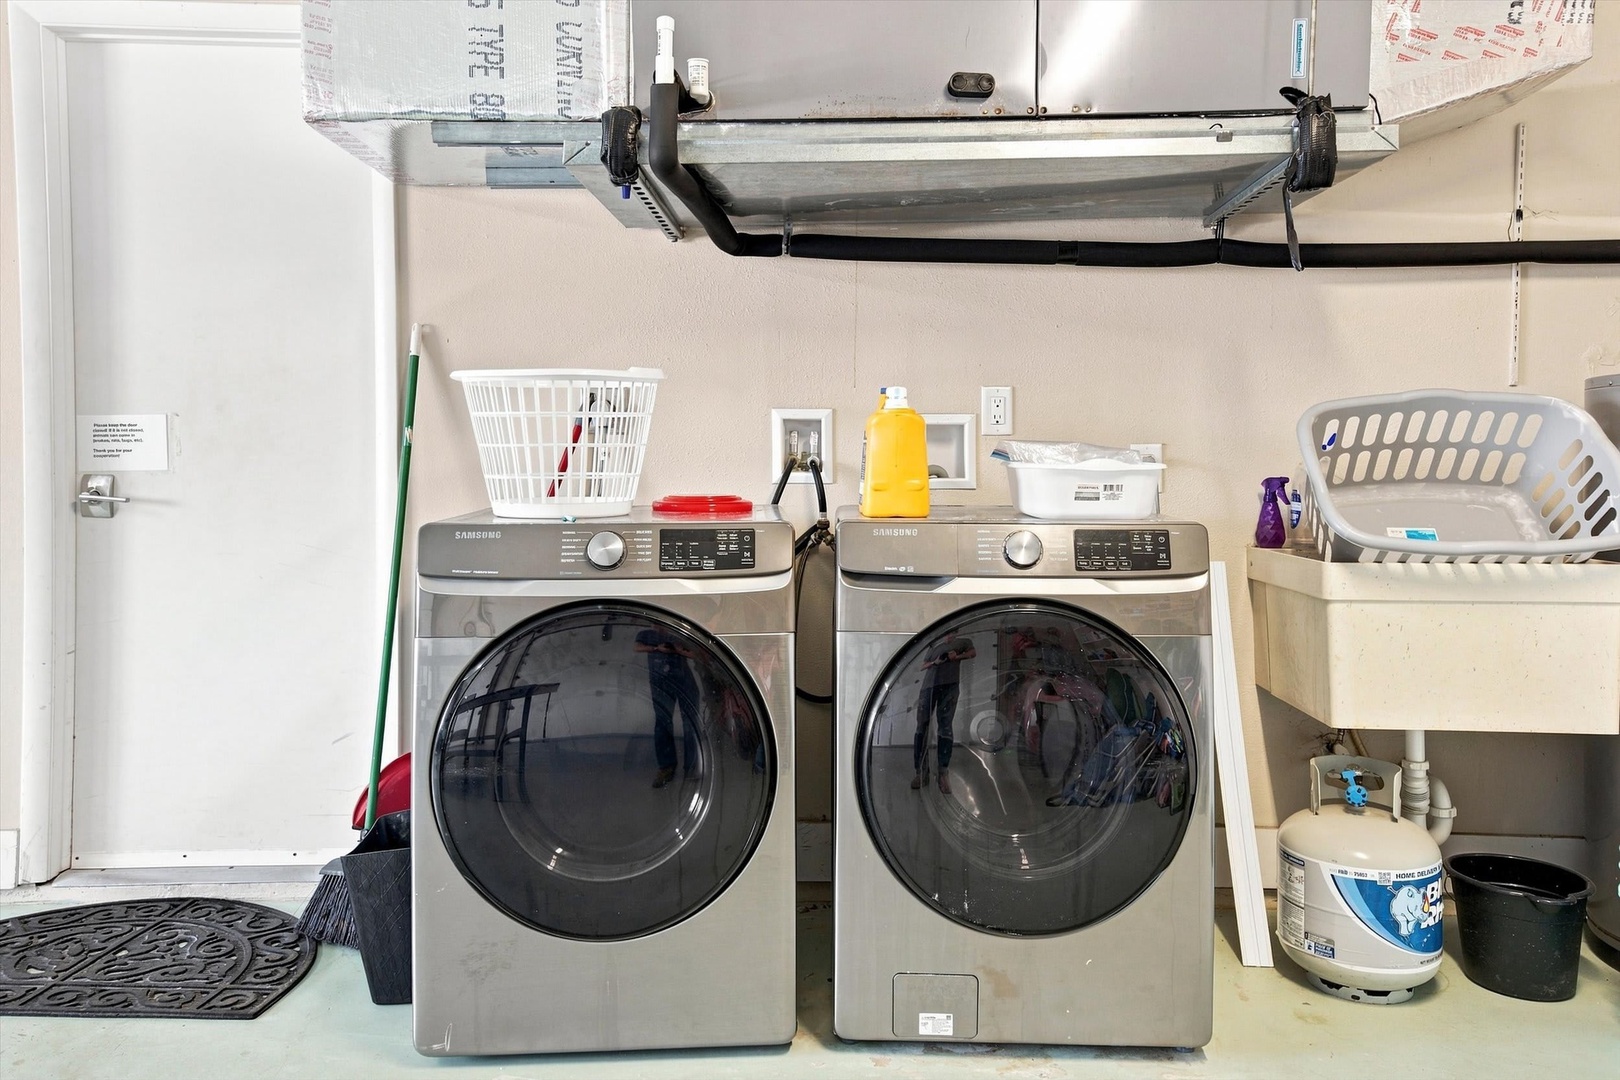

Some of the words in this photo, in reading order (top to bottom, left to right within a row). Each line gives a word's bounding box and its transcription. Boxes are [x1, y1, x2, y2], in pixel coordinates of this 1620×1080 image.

[468, 24, 505, 80] TYPE
[454, 531, 502, 540] SAMSUNG
[872, 528, 918, 537] SAMSUNG
[1395, 872, 1416, 880] HOME
